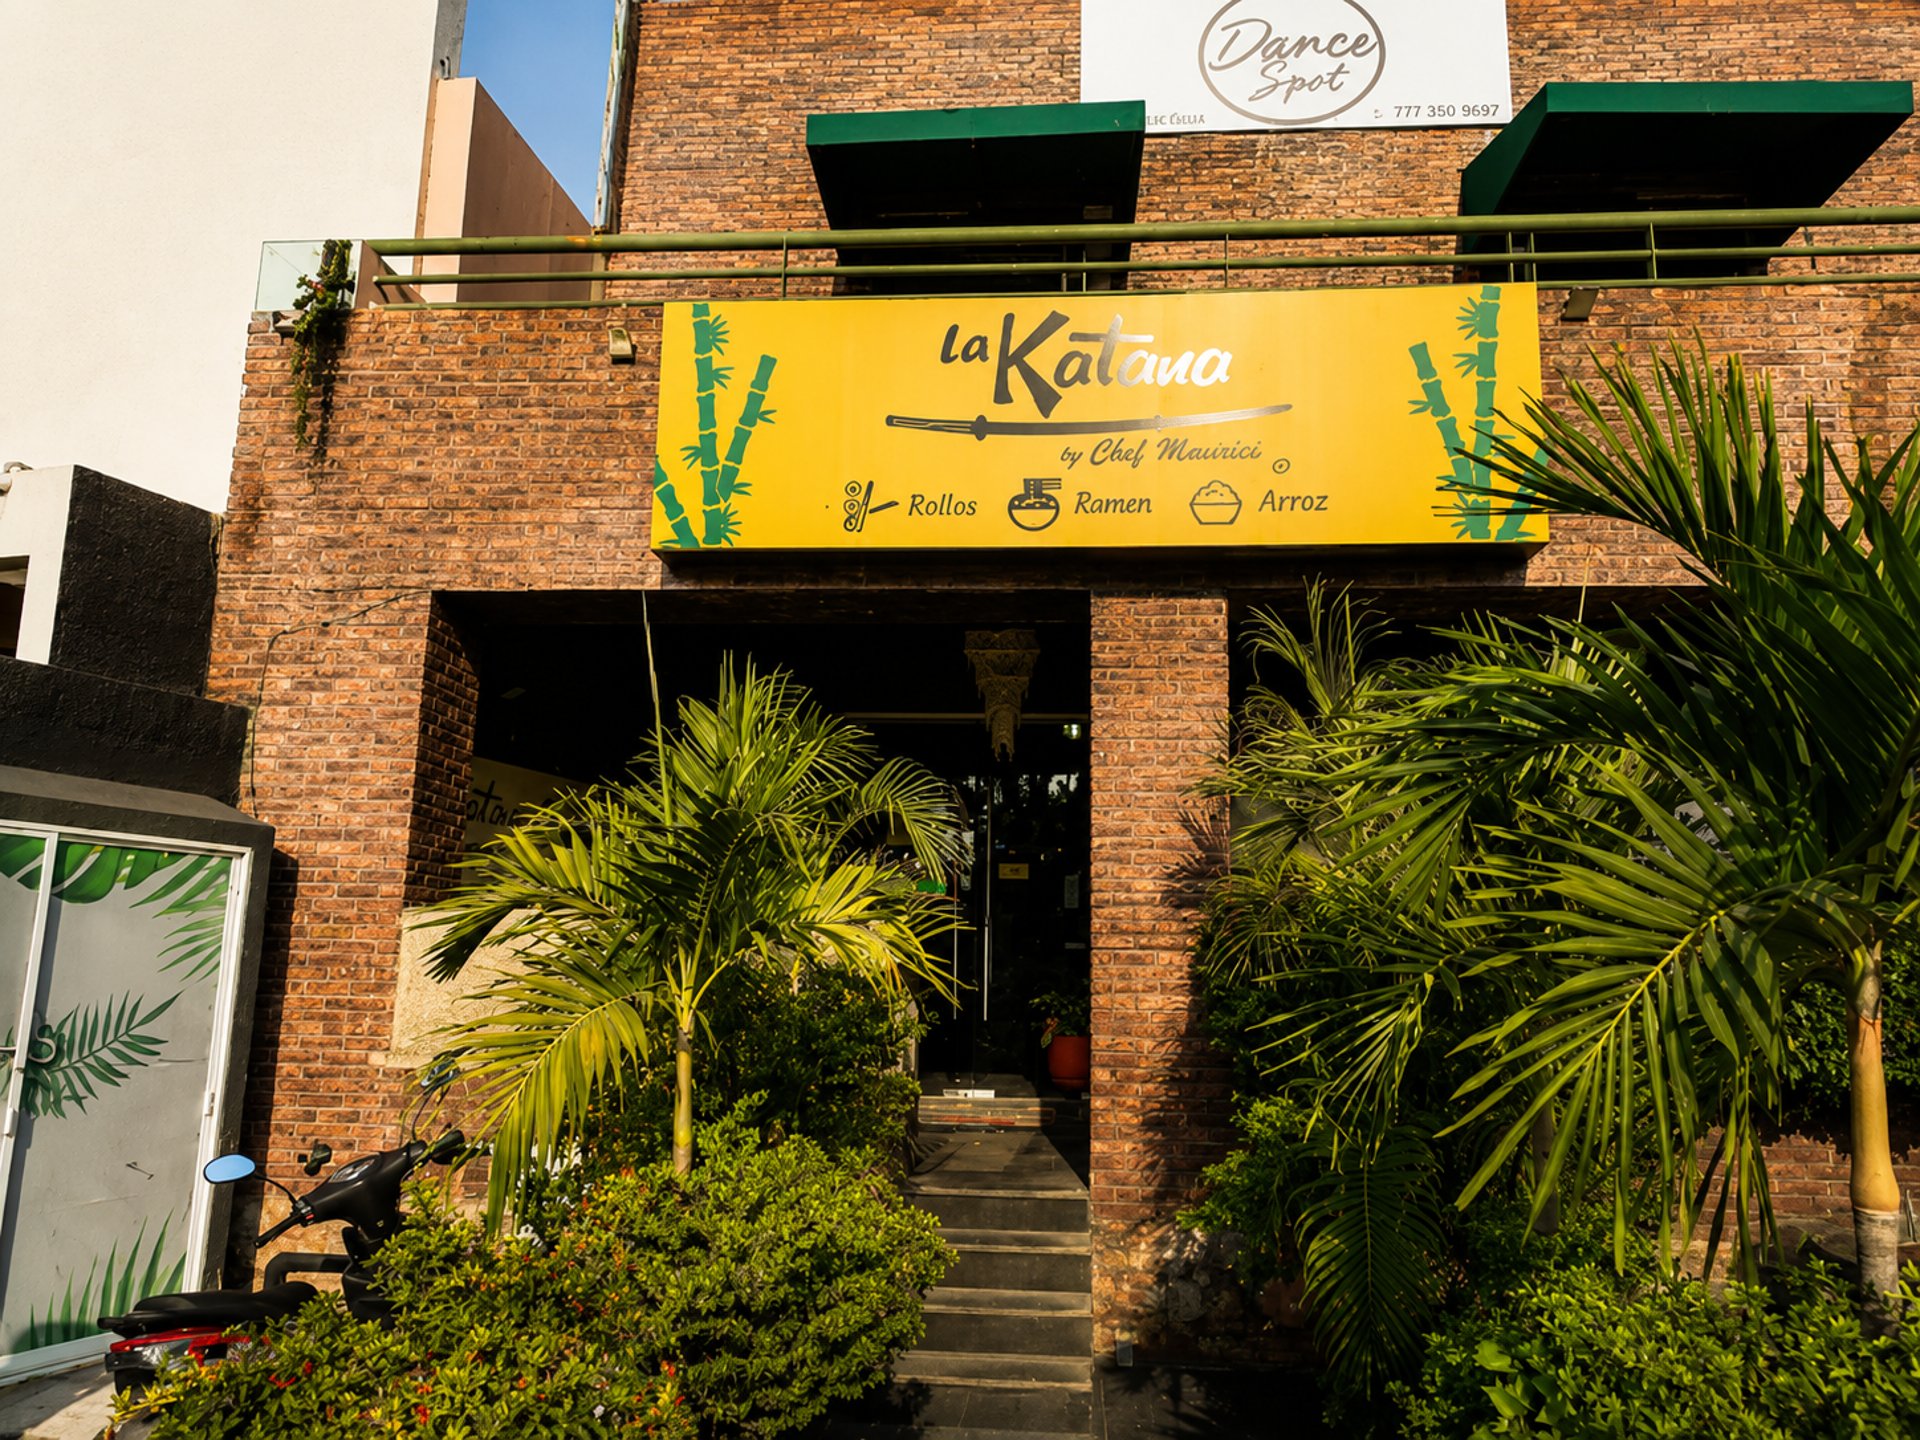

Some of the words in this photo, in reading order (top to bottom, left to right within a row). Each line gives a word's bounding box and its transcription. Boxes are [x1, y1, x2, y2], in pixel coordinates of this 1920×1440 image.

[1208, 18, 1379, 72] Dance
[1247, 59, 1350, 104] Spot
[1394, 106, 1421, 118] 777
[1427, 105, 1456, 118] 350
[1461, 104, 1500, 117] 9697
[993, 310, 1233, 419] Katana
[1060, 446, 1084, 470] by
[1089, 437, 1148, 469] Chef
[908, 494, 978, 516] Rollos
[1074, 491, 1153, 514] Ramen
[1258, 489, 1329, 512] Arroz
